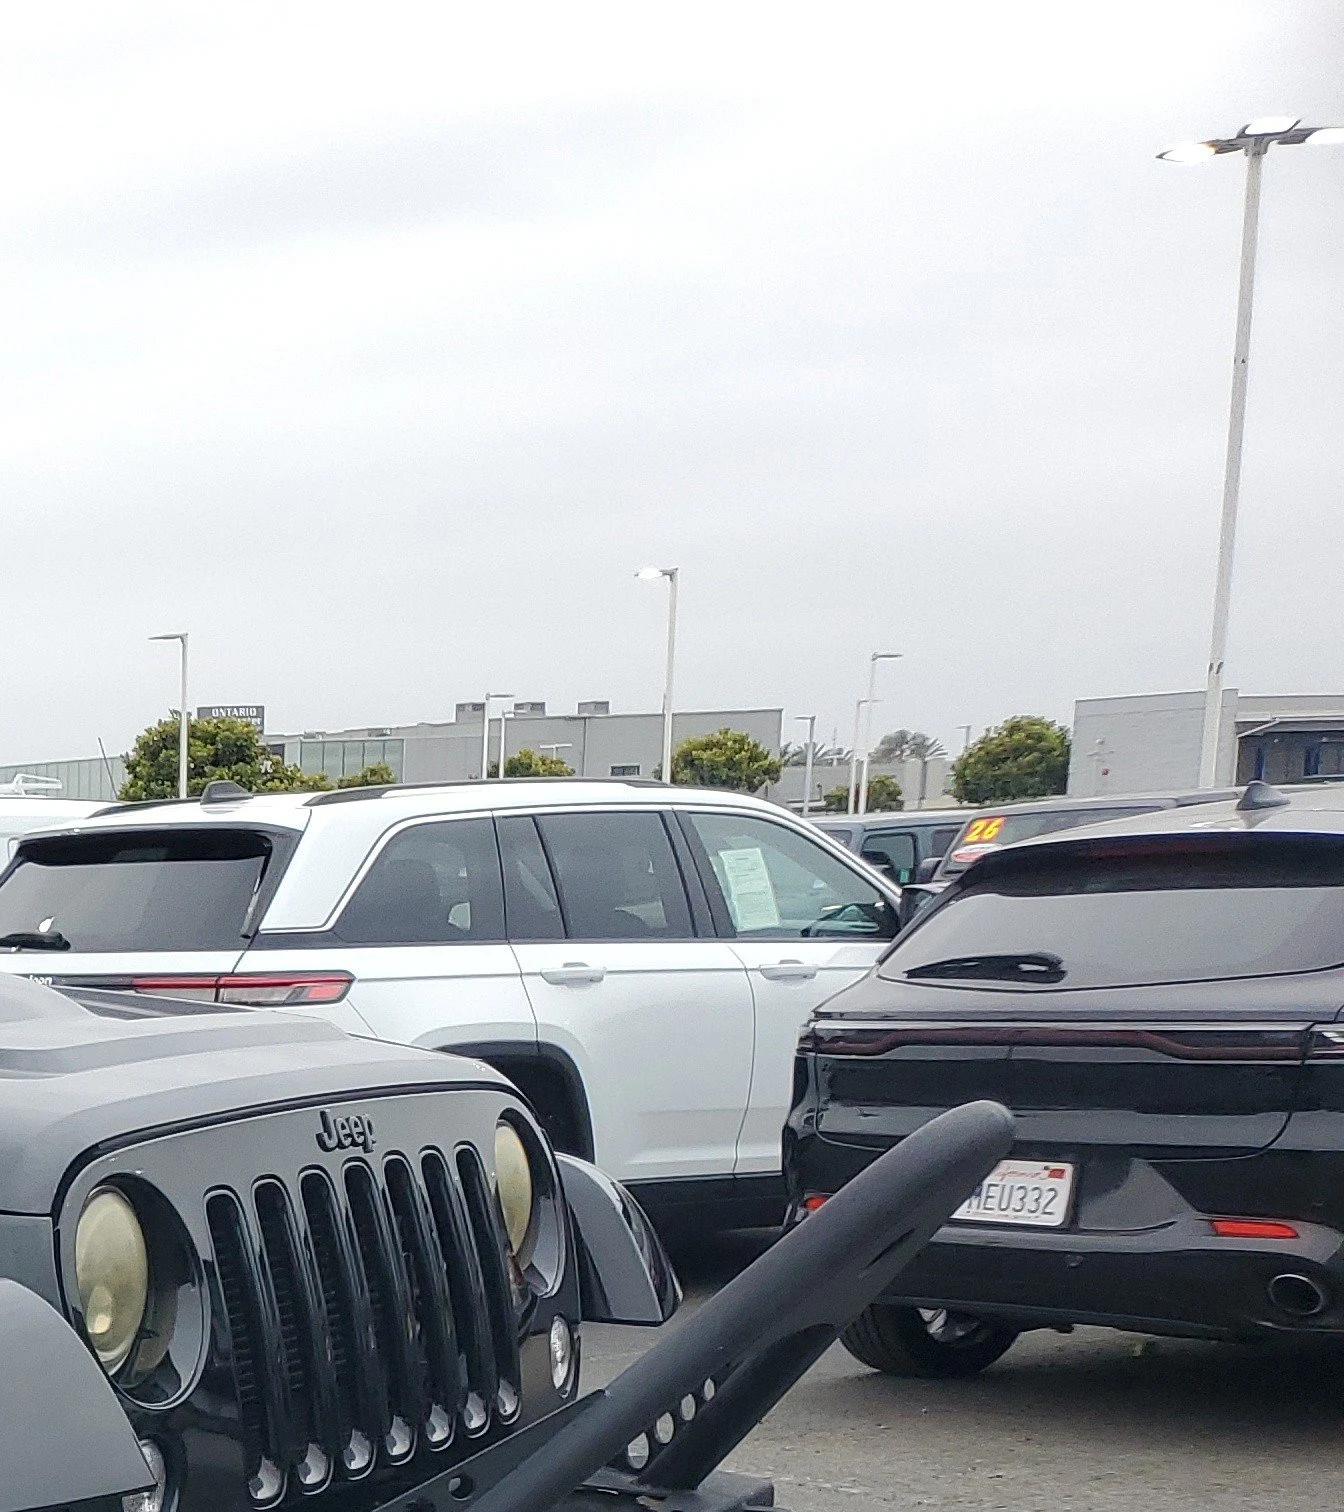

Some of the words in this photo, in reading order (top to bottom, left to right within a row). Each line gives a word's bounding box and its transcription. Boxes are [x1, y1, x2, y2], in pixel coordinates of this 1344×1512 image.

[212, 708, 257, 717] ONTARIO
[965, 818, 1002, 842] 26
[315, 1109, 377, 1154] Jeep
